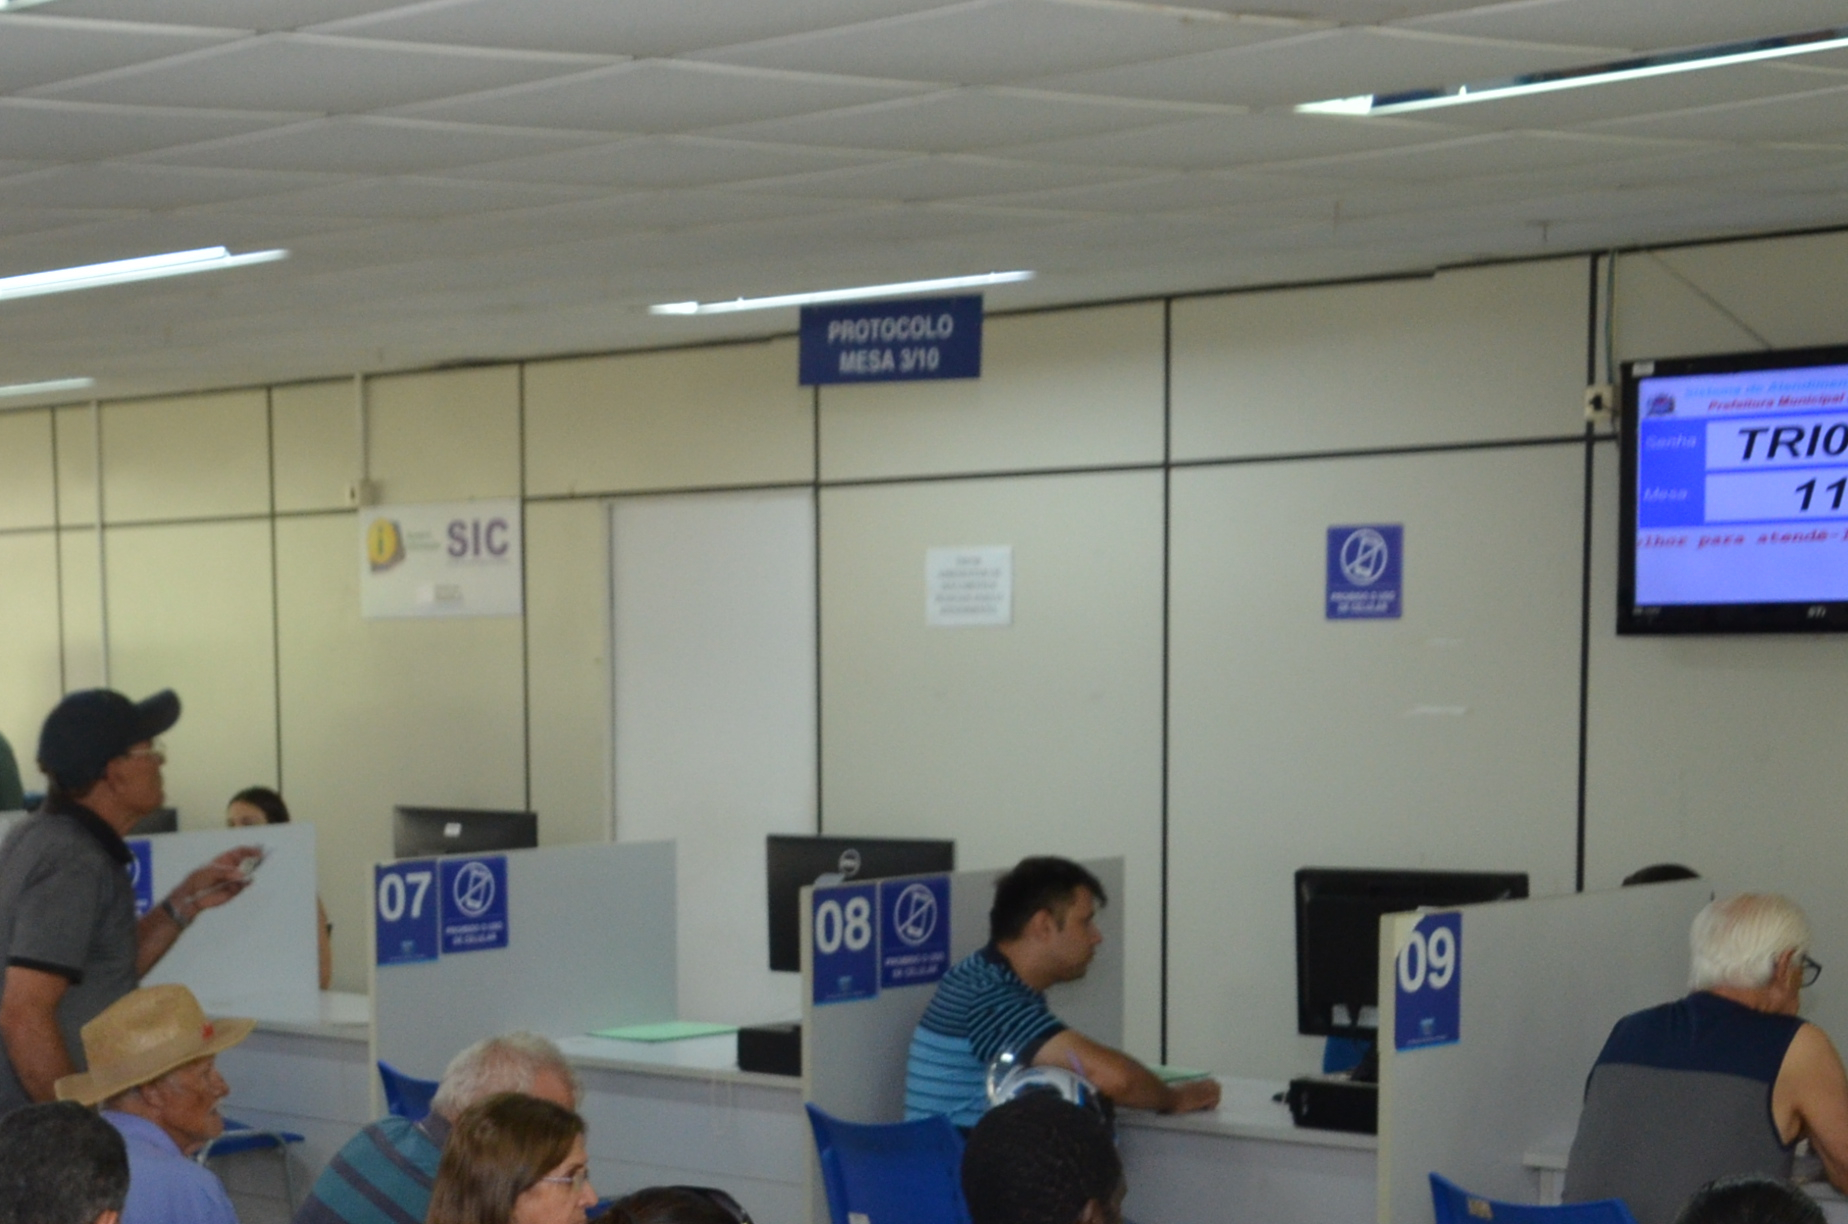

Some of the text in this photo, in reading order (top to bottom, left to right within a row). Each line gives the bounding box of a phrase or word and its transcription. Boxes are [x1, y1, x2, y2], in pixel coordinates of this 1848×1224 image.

[827, 313, 954, 344] PROTOCOLO
[839, 346, 940, 374] MESA 3/10
[447, 517, 509, 558] SIC
[378, 870, 433, 923] 07
[815, 896, 872, 955] 08
[1398, 926, 1455, 994] 09
